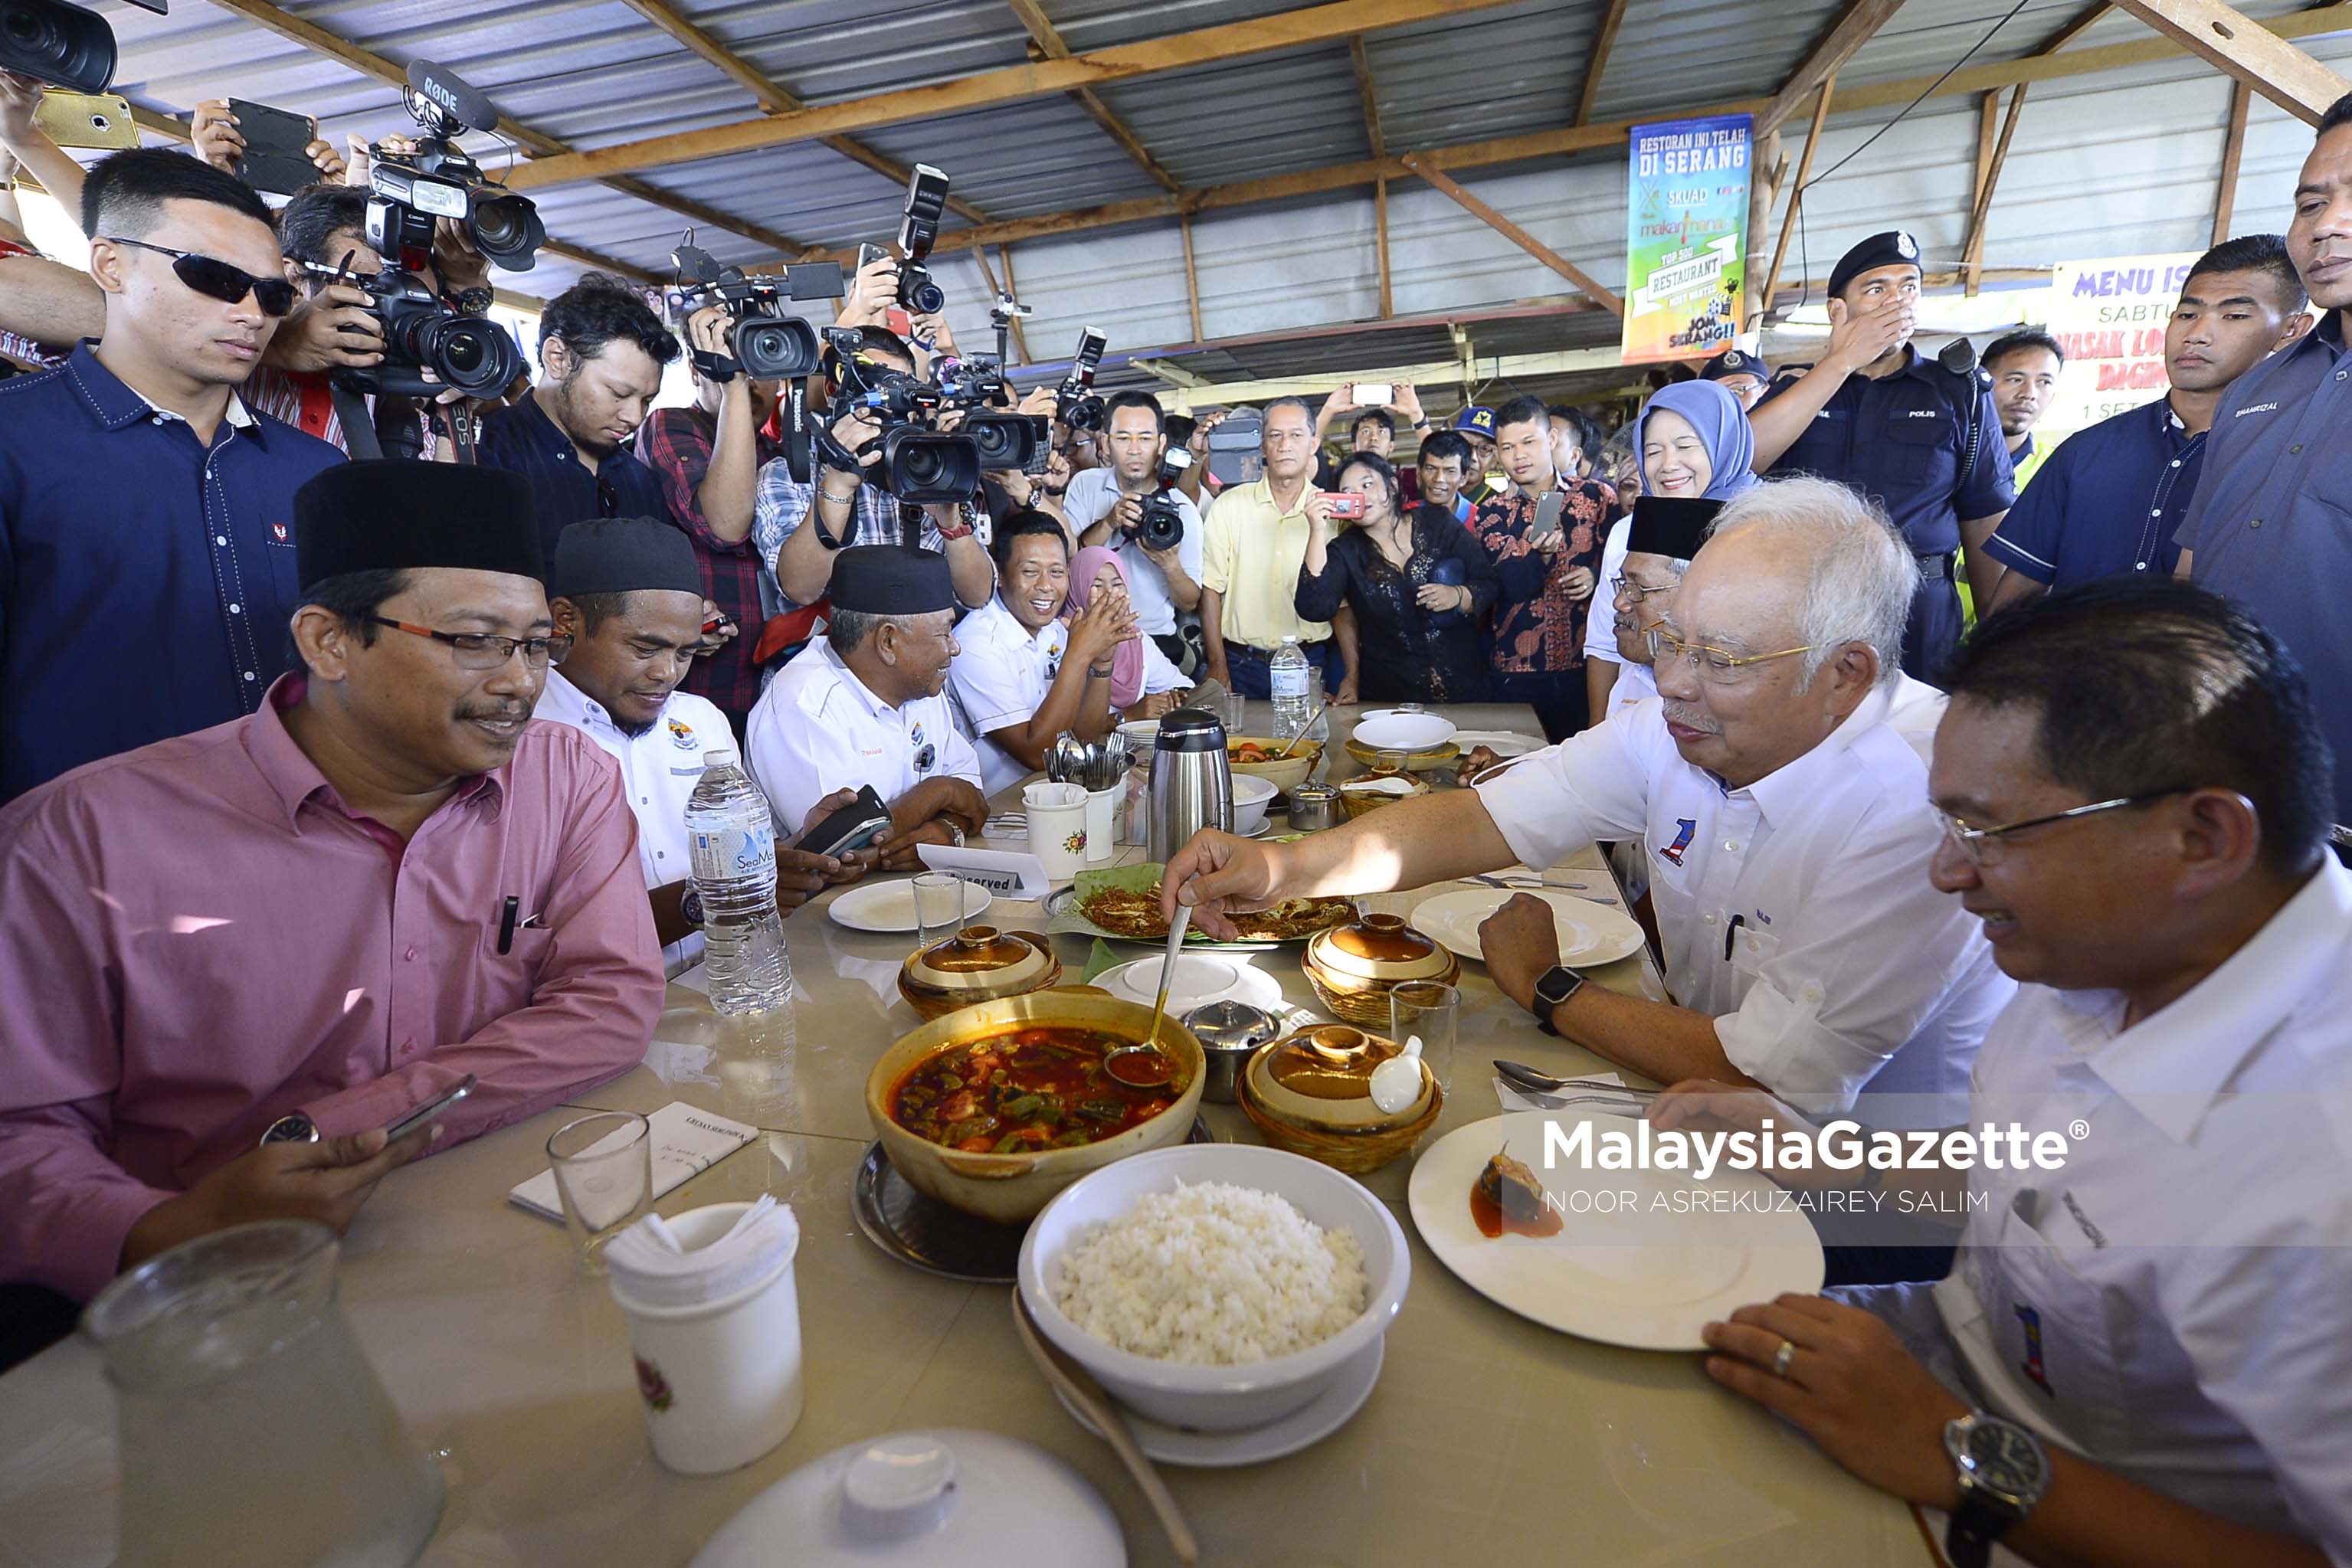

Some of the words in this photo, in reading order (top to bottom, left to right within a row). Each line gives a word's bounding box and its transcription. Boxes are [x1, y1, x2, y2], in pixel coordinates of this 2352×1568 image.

[1640, 133, 1692, 153] RESTORAN
[1695, 132, 1709, 148] INI
[1712, 129, 1745, 146] TELAH
[1639, 154, 1659, 177] DI
[1666, 146, 1744, 174] SERANG
[1668, 188, 1708, 205] SKUAD
[1653, 258, 1718, 293] RESTAURANT
[2072, 268, 2154, 299] MENU
[407, 290, 431, 299] Canon
[1689, 315, 1715, 331] JOM
[794, 388, 804, 433] Panasonic
[2083, 404, 2089, 419] 1
[453, 404, 470, 447] EOS
